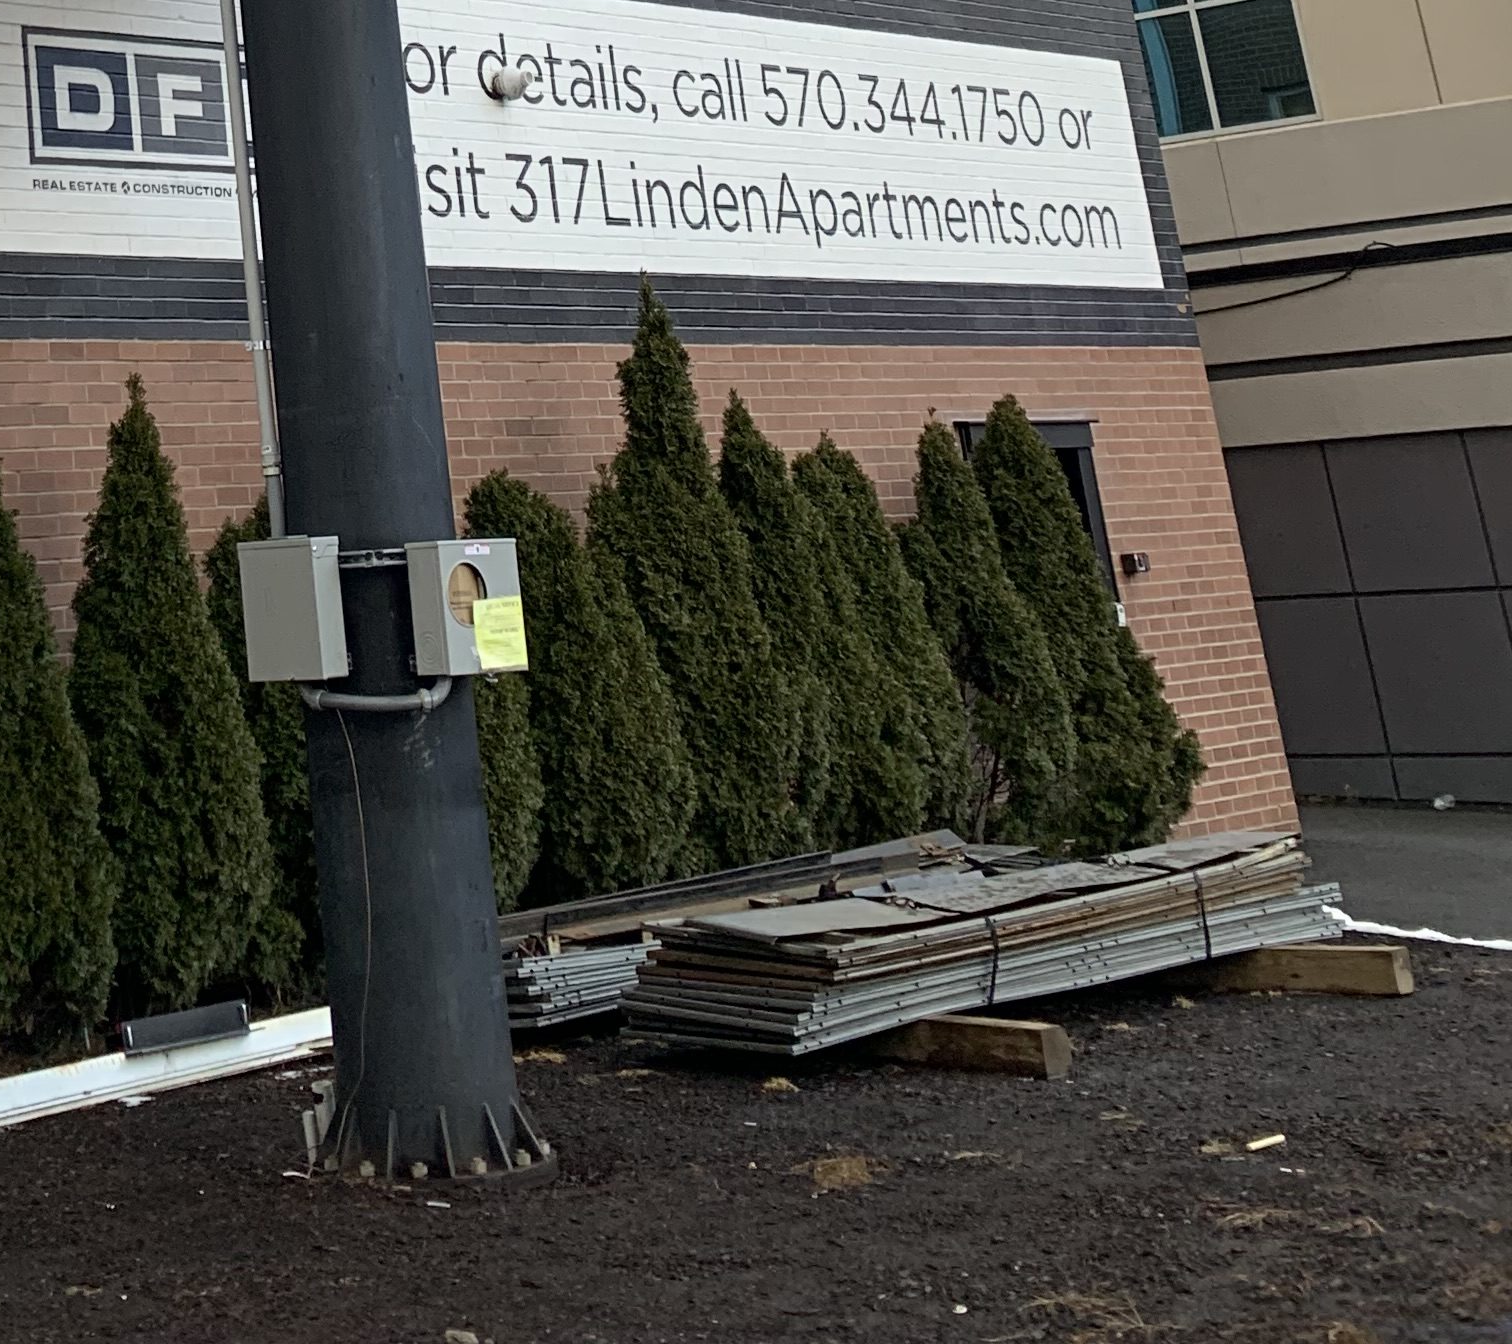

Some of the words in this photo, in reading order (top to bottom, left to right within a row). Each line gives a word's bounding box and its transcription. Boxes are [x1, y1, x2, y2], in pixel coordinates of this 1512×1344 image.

[402, 42, 457, 96] or
[477, 33, 659, 123] details,
[672, 58, 748, 123] call
[760, 64, 1045, 147] 570.344.1750
[1059, 107, 1093, 150] or
[33, 179, 66, 191] REAL
[69, 180, 118, 193] ESTATE
[133, 183, 232, 198] CONSTRUCTION
[413, 145, 490, 220] sit
[505, 153, 1122, 249] 317LindenApartments.com
